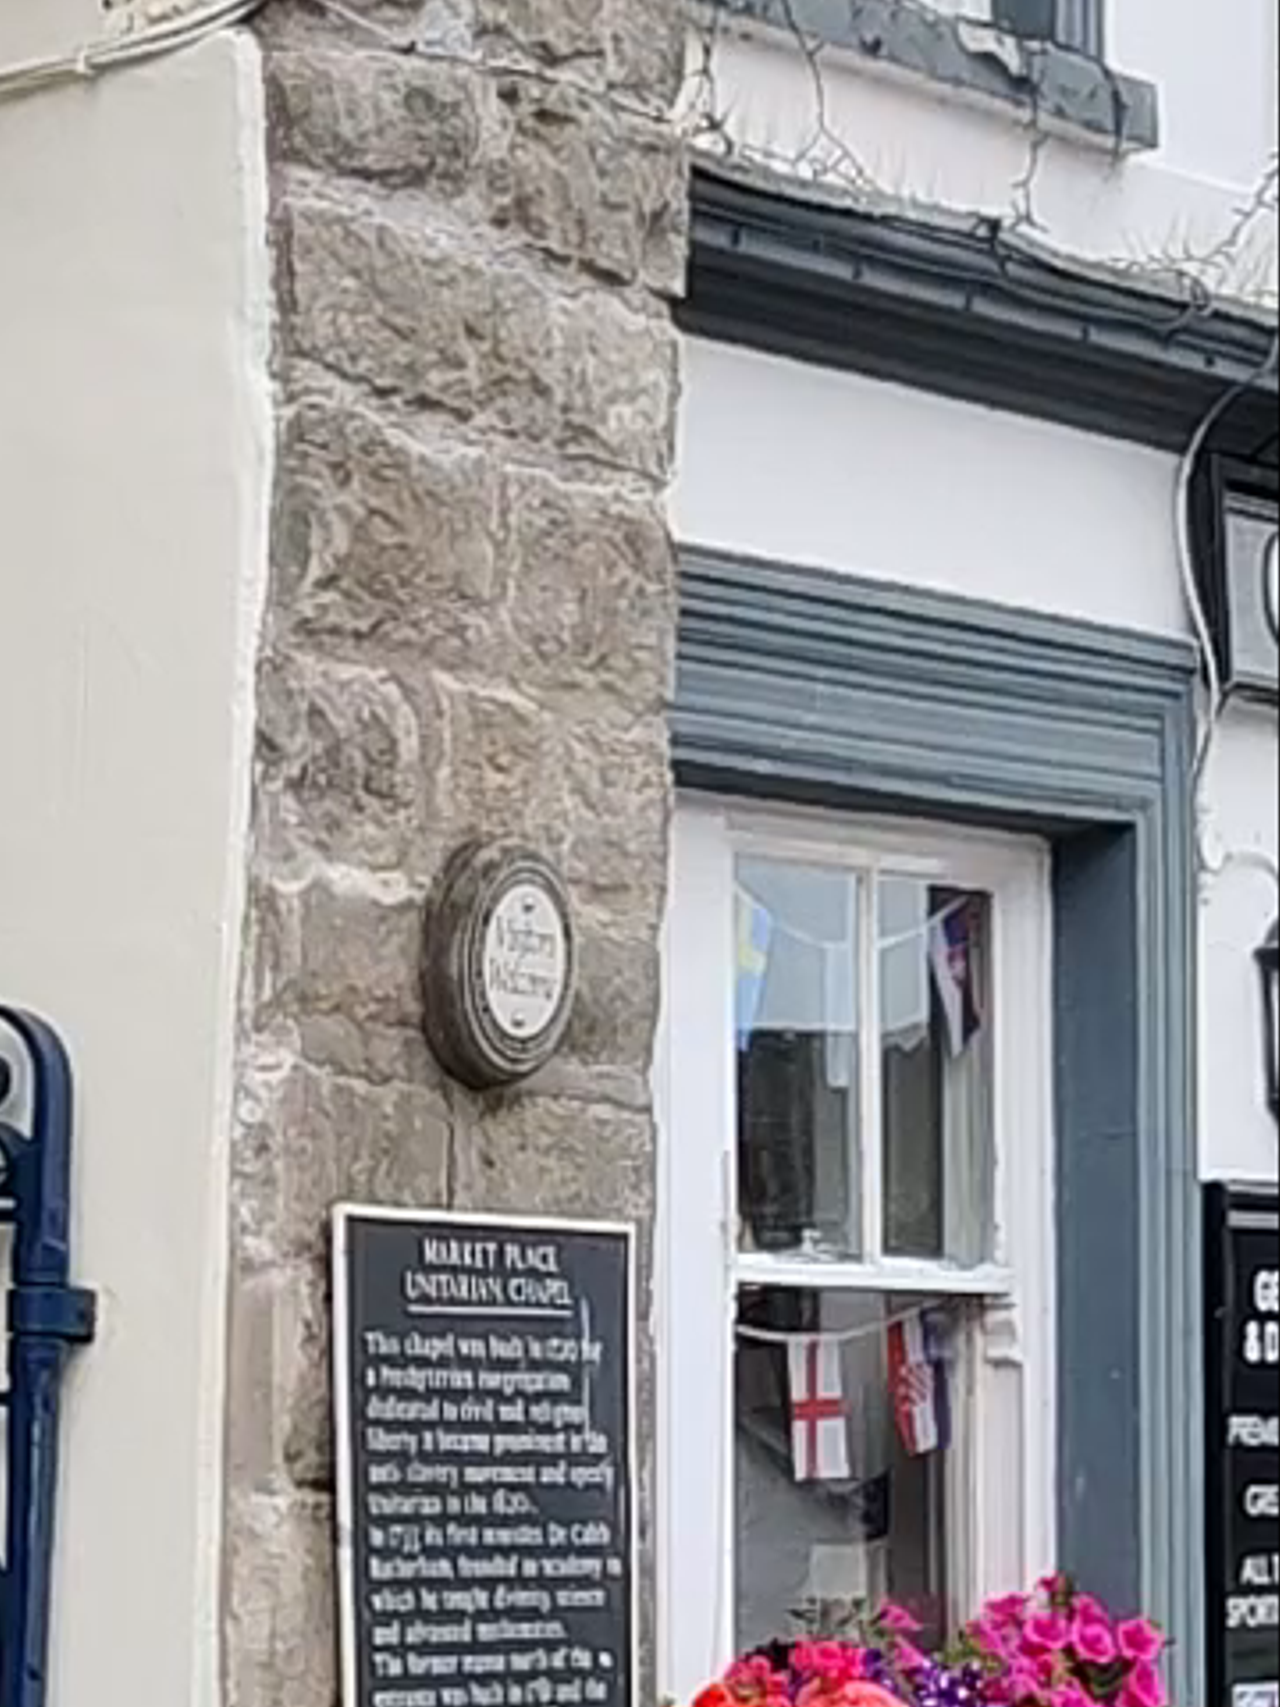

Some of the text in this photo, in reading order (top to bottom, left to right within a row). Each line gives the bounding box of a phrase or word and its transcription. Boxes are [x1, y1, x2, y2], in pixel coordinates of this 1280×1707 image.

[424, 1238, 560, 1273] MARKET PLACE
[404, 1270, 573, 1305] UNITARIAN CHAPEL
